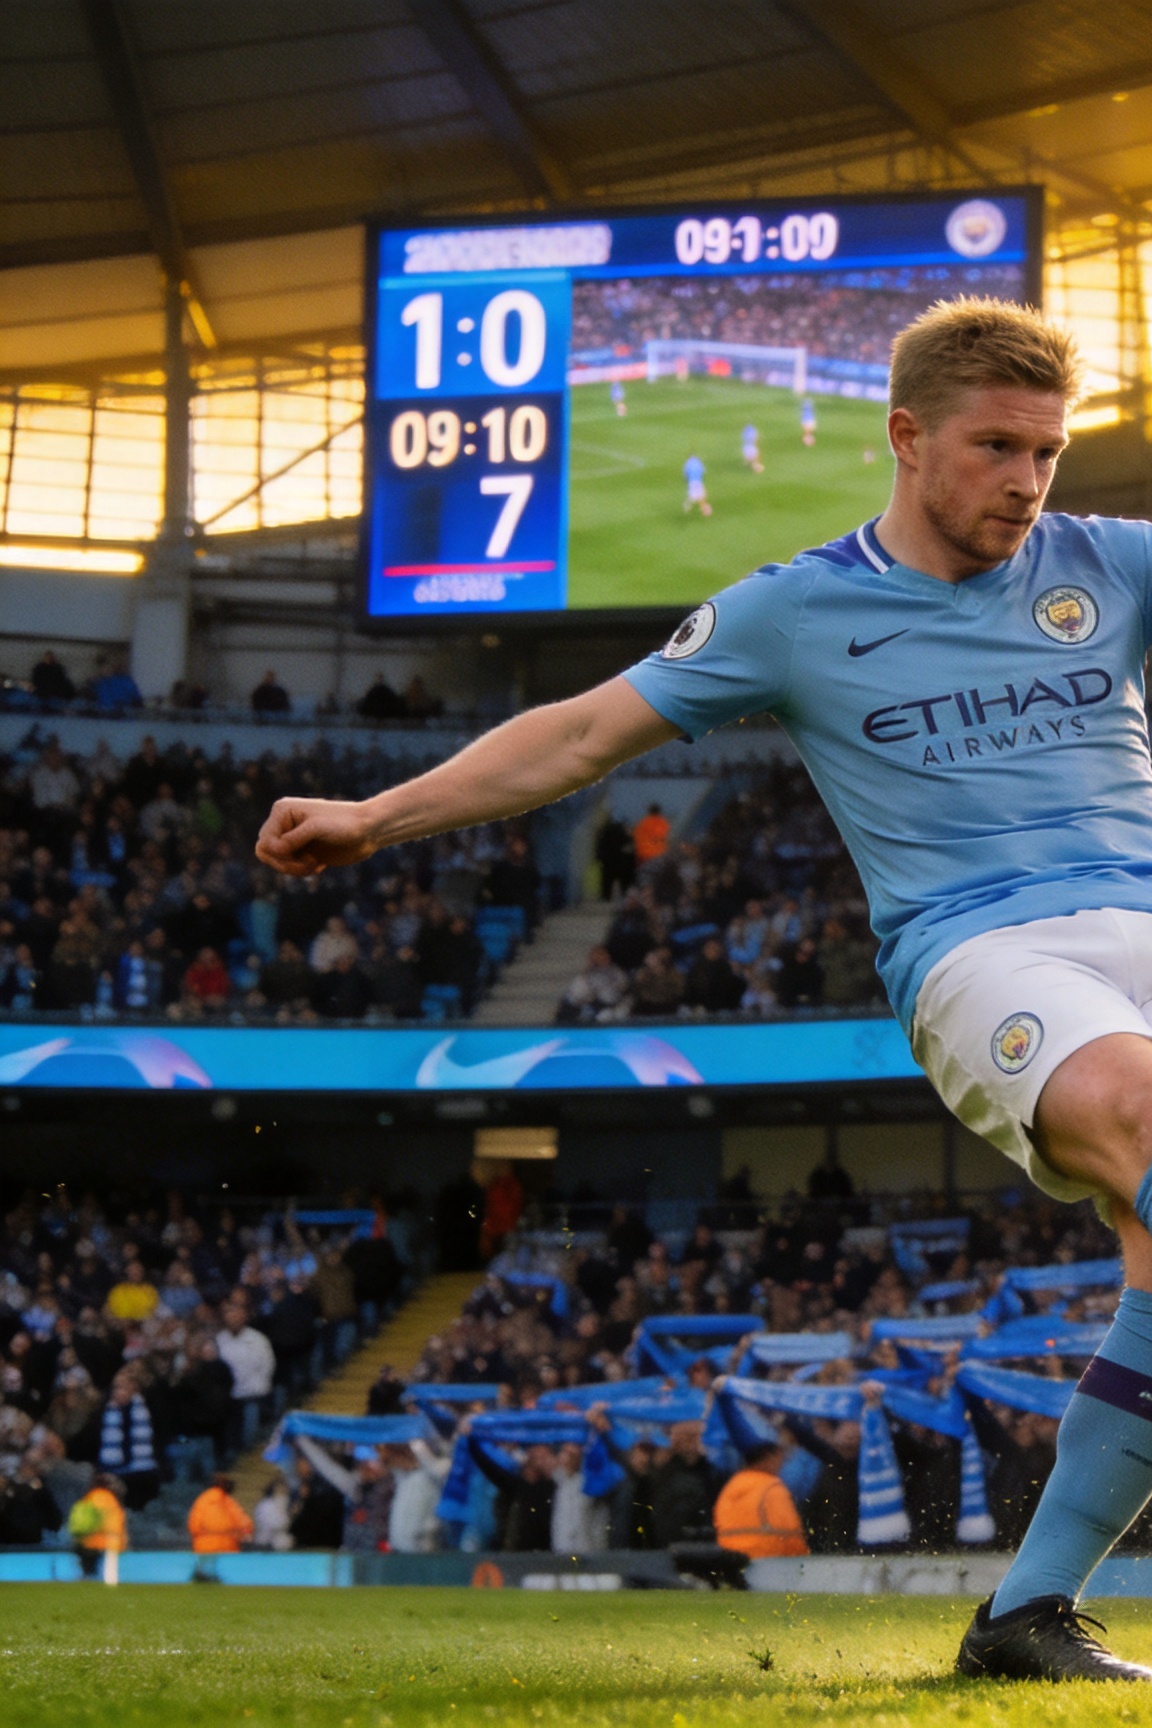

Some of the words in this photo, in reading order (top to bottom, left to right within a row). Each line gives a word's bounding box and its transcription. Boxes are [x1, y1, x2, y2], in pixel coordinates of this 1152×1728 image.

[401, 289, 547, 389] 1:0
[390, 405, 548, 469] 09:10
[479, 473, 534, 559] 7
[861, 668, 1113, 744] ETIHAD
[922, 714, 1087, 766] AIRWAYS
